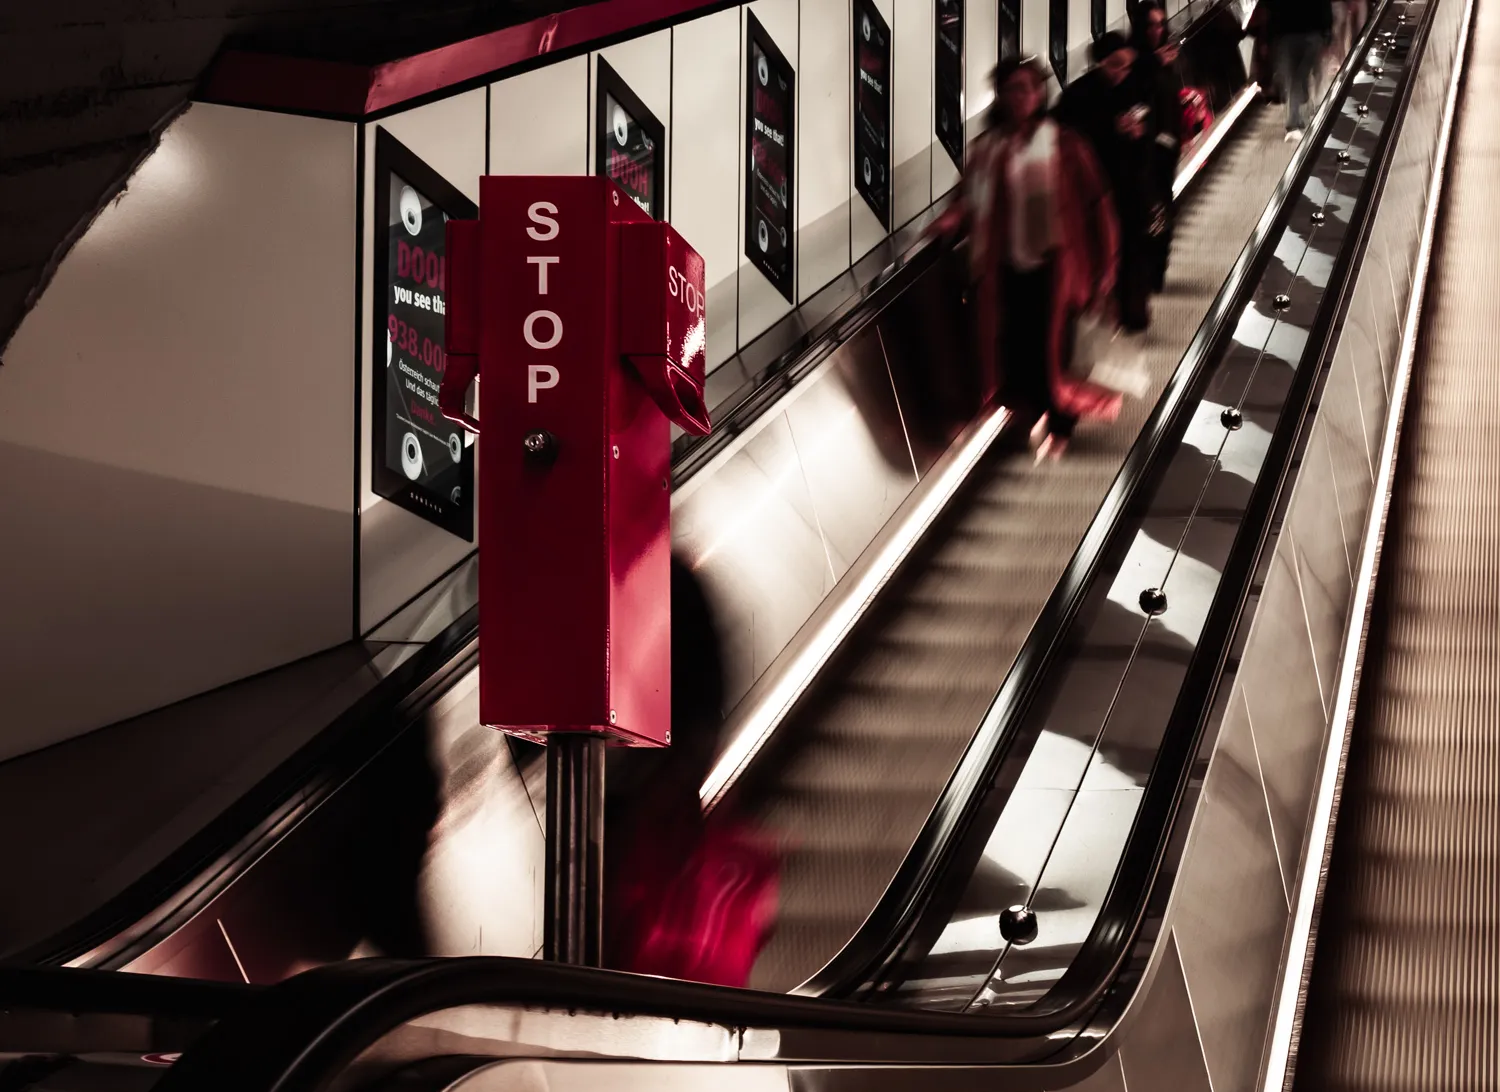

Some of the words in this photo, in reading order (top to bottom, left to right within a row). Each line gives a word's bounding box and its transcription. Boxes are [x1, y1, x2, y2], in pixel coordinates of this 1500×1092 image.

[754, 117, 764, 133] you
[764, 124, 773, 139] see
[611, 148, 649, 198] DOOH
[393, 285, 412, 305] you
[413, 292, 431, 311] see
[523, 201, 563, 403] STOP
[668, 265, 705, 317] STOP
[388, 313, 446, 373] 938.00
[398, 357, 424, 383] Österreich
[405, 378, 416, 393] Und
[416, 385, 426, 398] das
